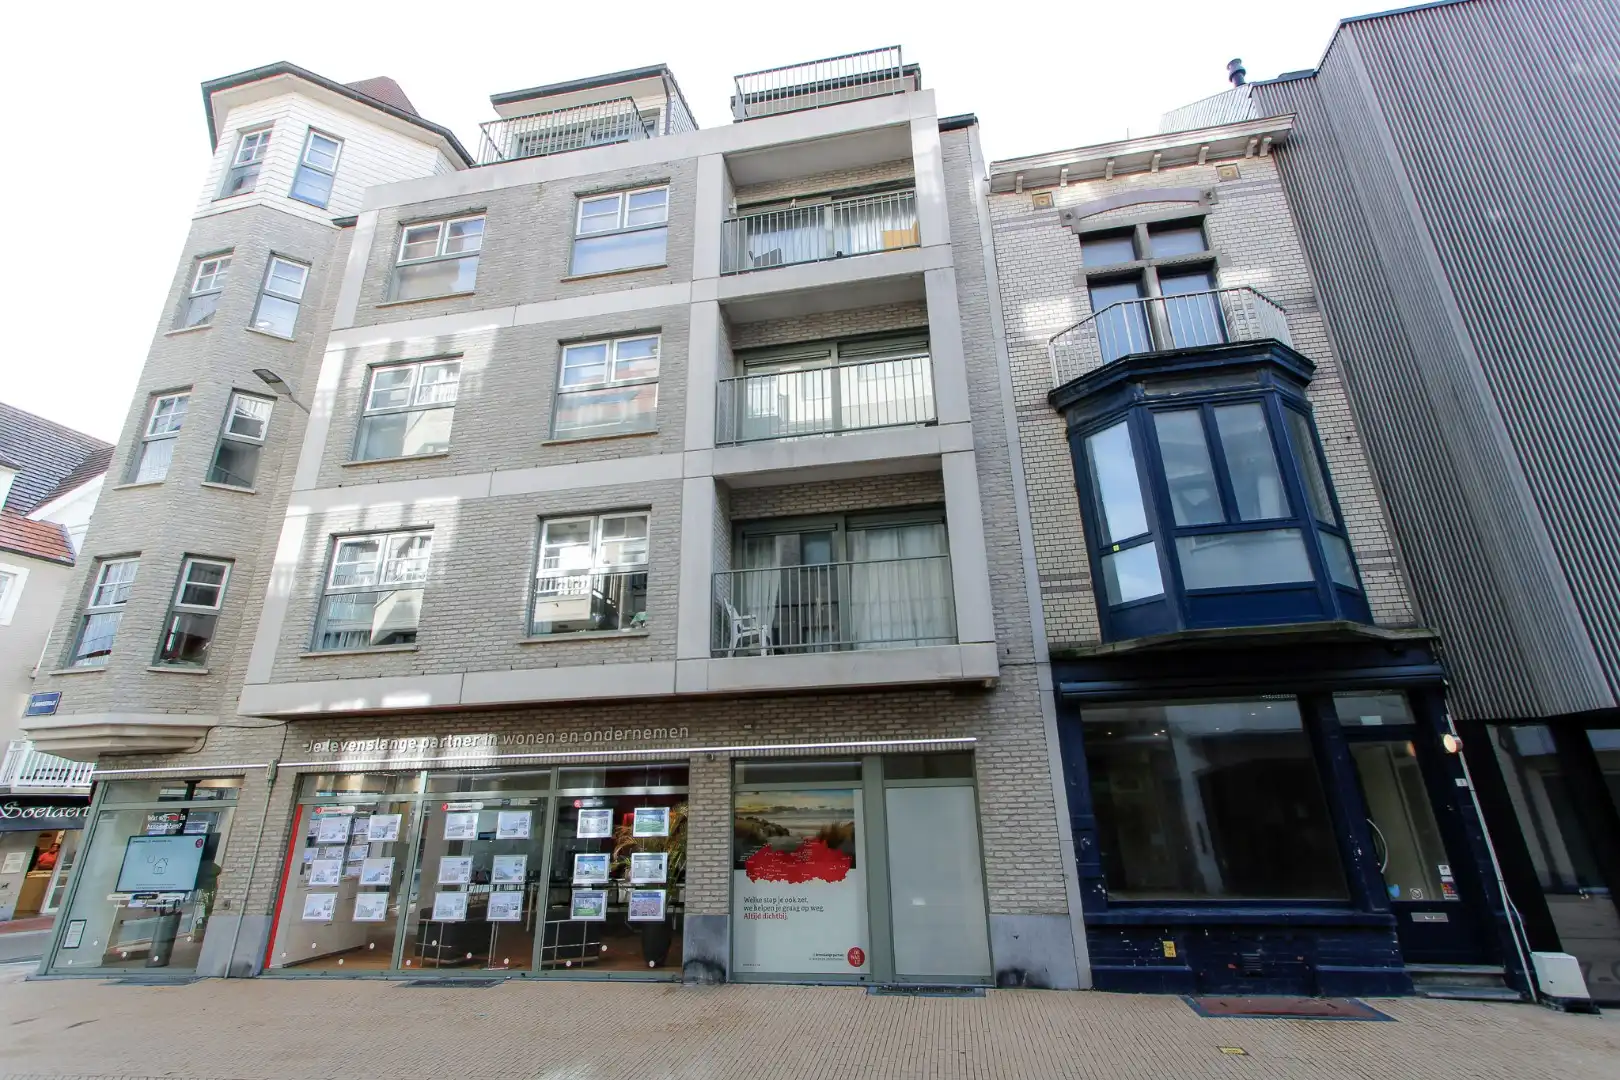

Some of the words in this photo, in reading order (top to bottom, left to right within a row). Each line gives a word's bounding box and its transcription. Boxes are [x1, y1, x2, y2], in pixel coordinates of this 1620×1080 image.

[304, 740, 321, 753] Je
[326, 737, 418, 754] levenslange
[421, 734, 481, 751] partner
[484, 733, 499, 747] in
[503, 731, 555, 745] wonen
[559, 731, 579, 743] en
[583, 726, 689, 742] ondernemen
[778, 896, 783, 904] je
